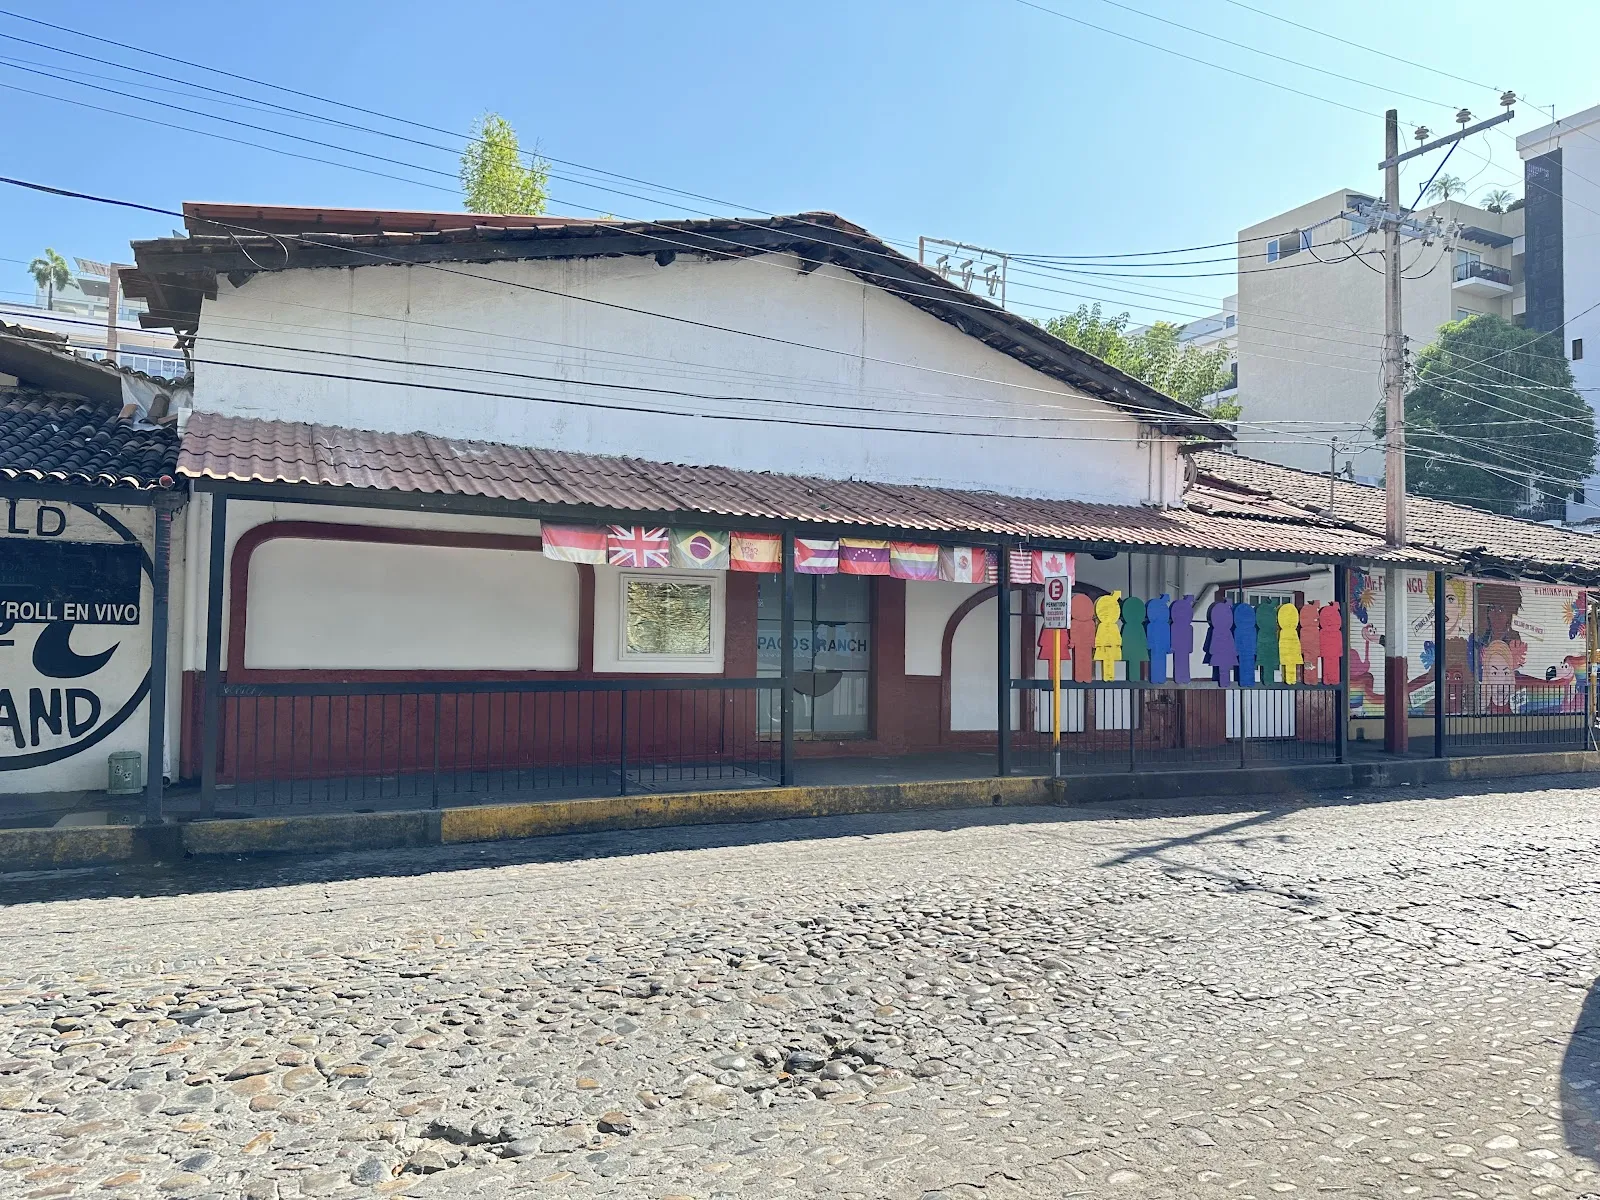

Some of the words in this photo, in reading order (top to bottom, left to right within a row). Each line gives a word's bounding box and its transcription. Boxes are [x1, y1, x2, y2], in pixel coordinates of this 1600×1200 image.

[1052, 582, 1061, 597] E
[63, 602, 89, 621] EN
[94, 603, 138, 622] VIVO
